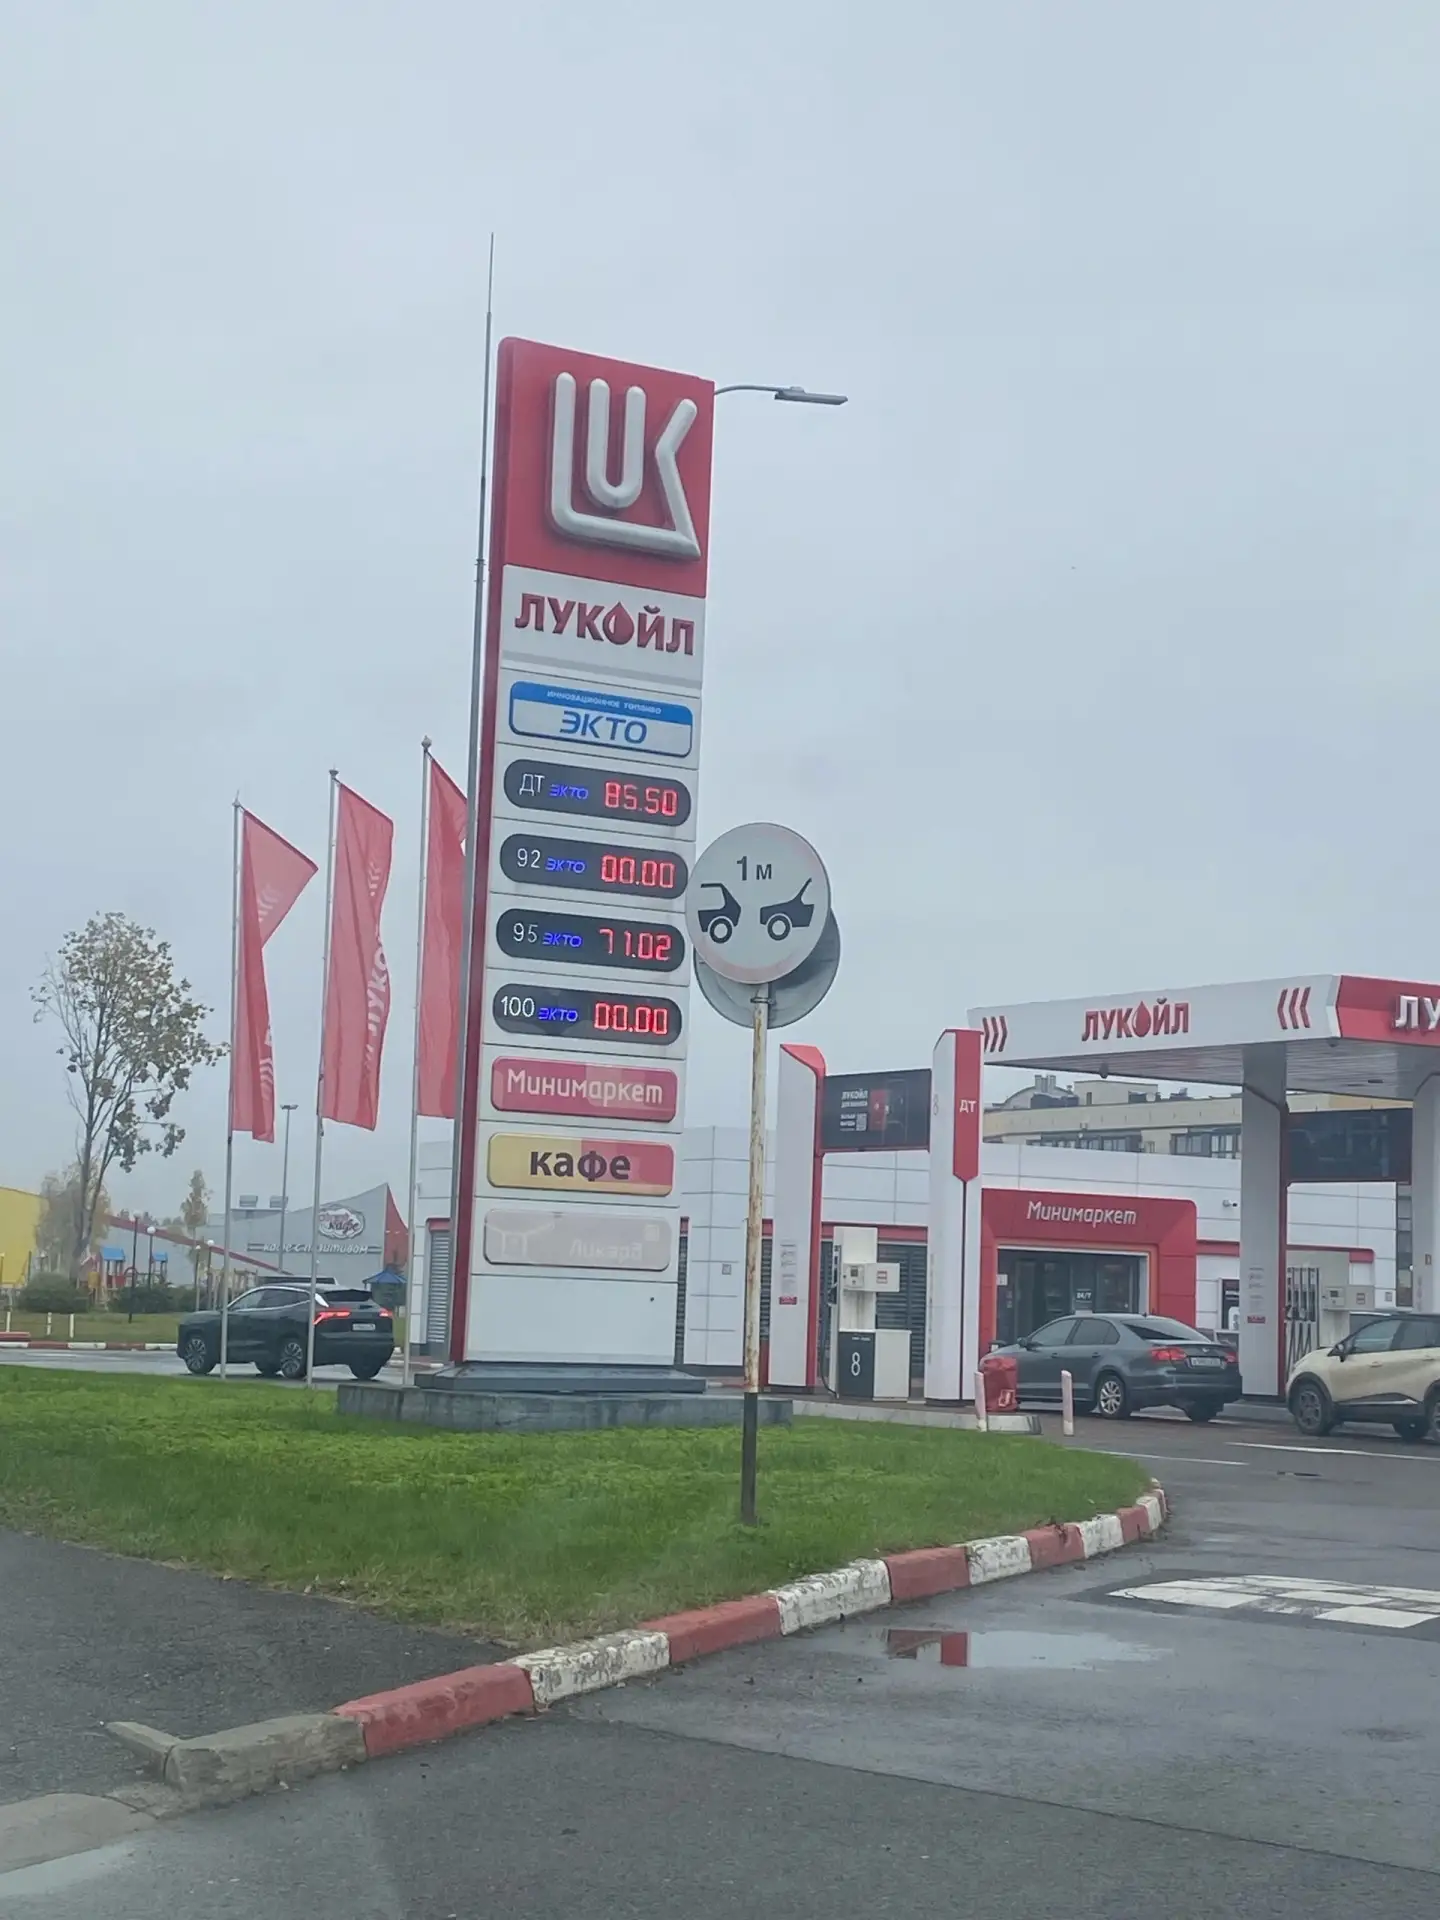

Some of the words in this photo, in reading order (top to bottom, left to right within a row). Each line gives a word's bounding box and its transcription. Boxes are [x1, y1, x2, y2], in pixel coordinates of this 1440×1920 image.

[514, 592, 695, 656] ЛУКОЙЛ
[559, 710, 648, 744] ЭКТО
[518, 773, 546, 797] ДТ
[549, 783, 589, 800] ЭКТО
[604, 782, 678, 817] 85.50
[517, 848, 541, 869] 92
[545, 857, 587, 873] ЭКТО
[601, 854, 676, 888] 00.00
[736, 855, 748, 881] 1
[512, 922, 539, 943] 95
[542, 932, 583, 948] ЭКТО
[599, 928, 672, 961] 71.02
[500, 996, 535, 1018] 100
[538, 1007, 579, 1022] ЭКТО
[594, 1002, 668, 1036] 00.00
[1081, 997, 1189, 1042] ЛУКОЙЛ
[506, 1067, 663, 1107] Минимаркет
[959, 1099, 977, 1114] ДТ
[529, 1150, 631, 1182] кафе
[1026, 1200, 1137, 1228] Минимаркет
[851, 1352, 860, 1376] 8
